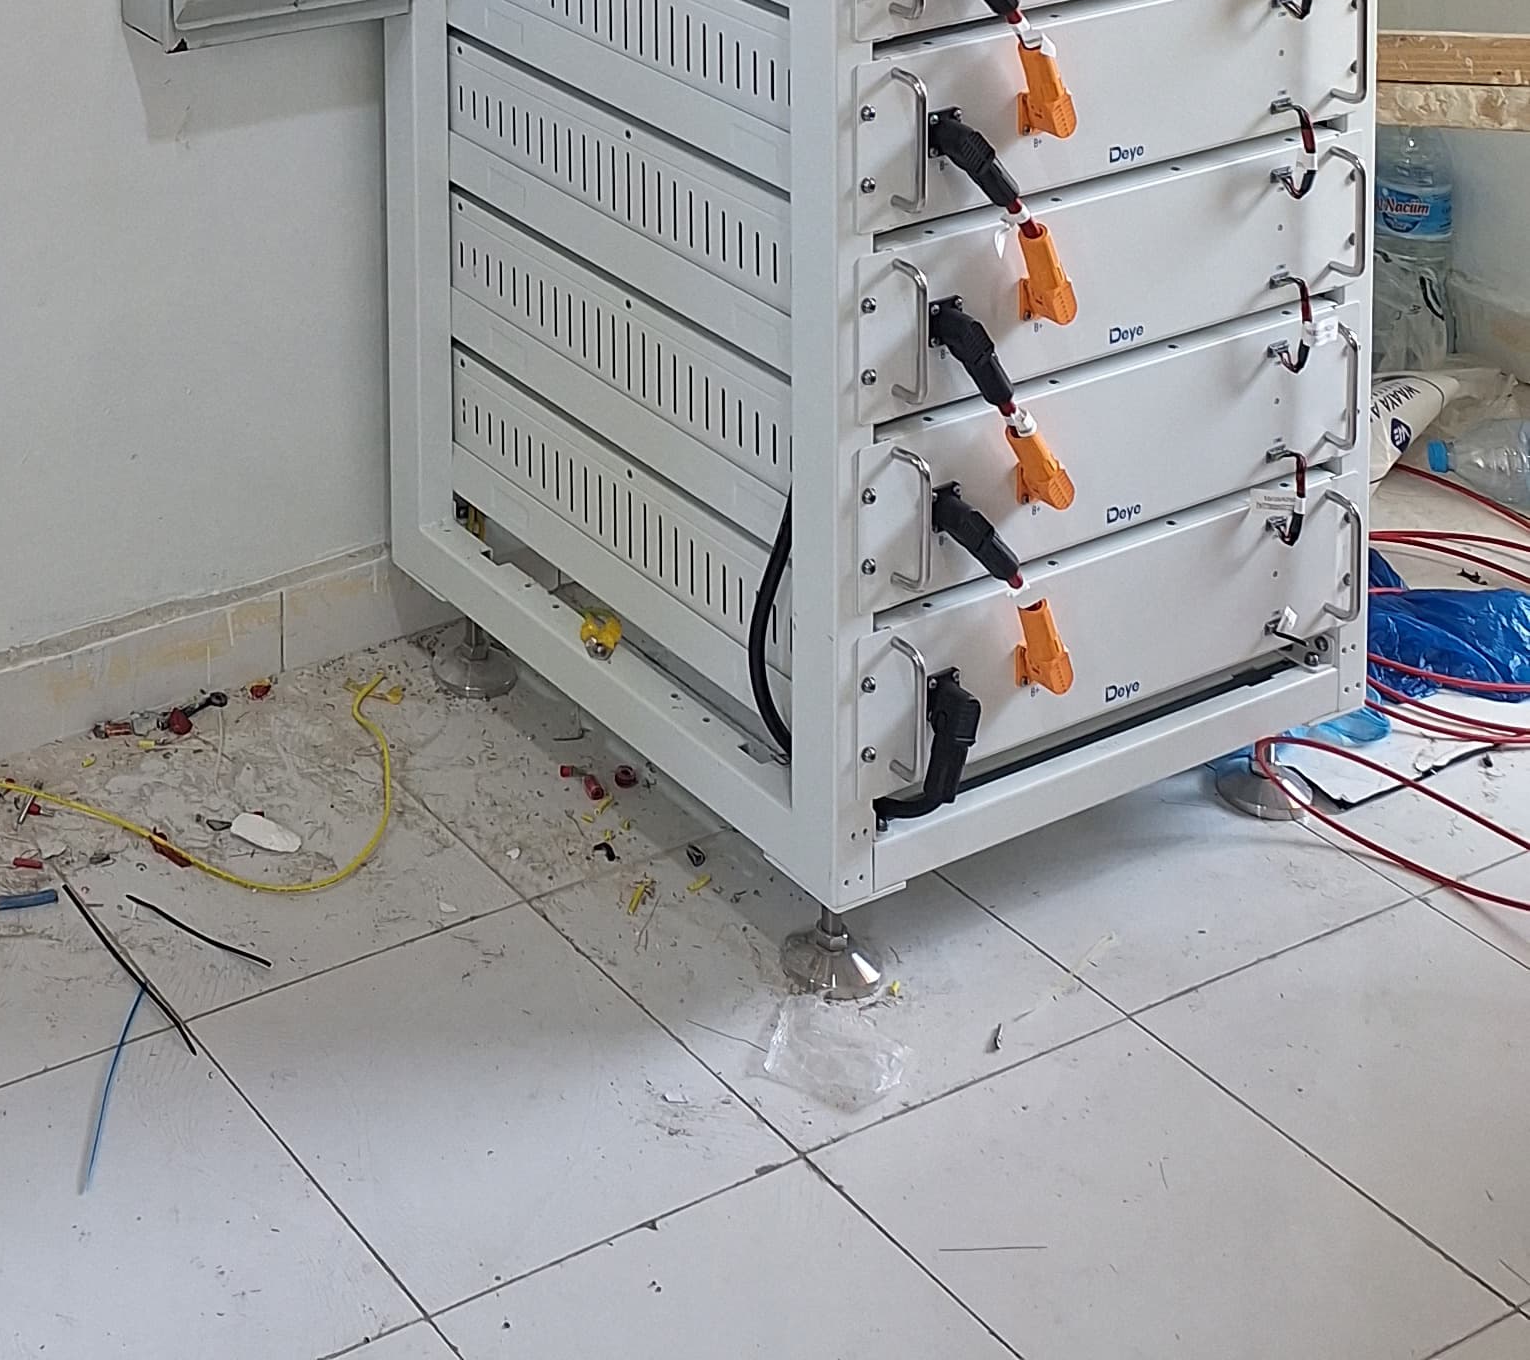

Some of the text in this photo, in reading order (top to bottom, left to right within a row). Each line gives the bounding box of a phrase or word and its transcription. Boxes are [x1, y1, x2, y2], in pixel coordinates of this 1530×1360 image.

[1109, 144, 1144, 163] Deye
[1109, 325, 1144, 344] Deye
[1106, 504, 1142, 523] Deye
[1105, 681, 1141, 702] Deye
